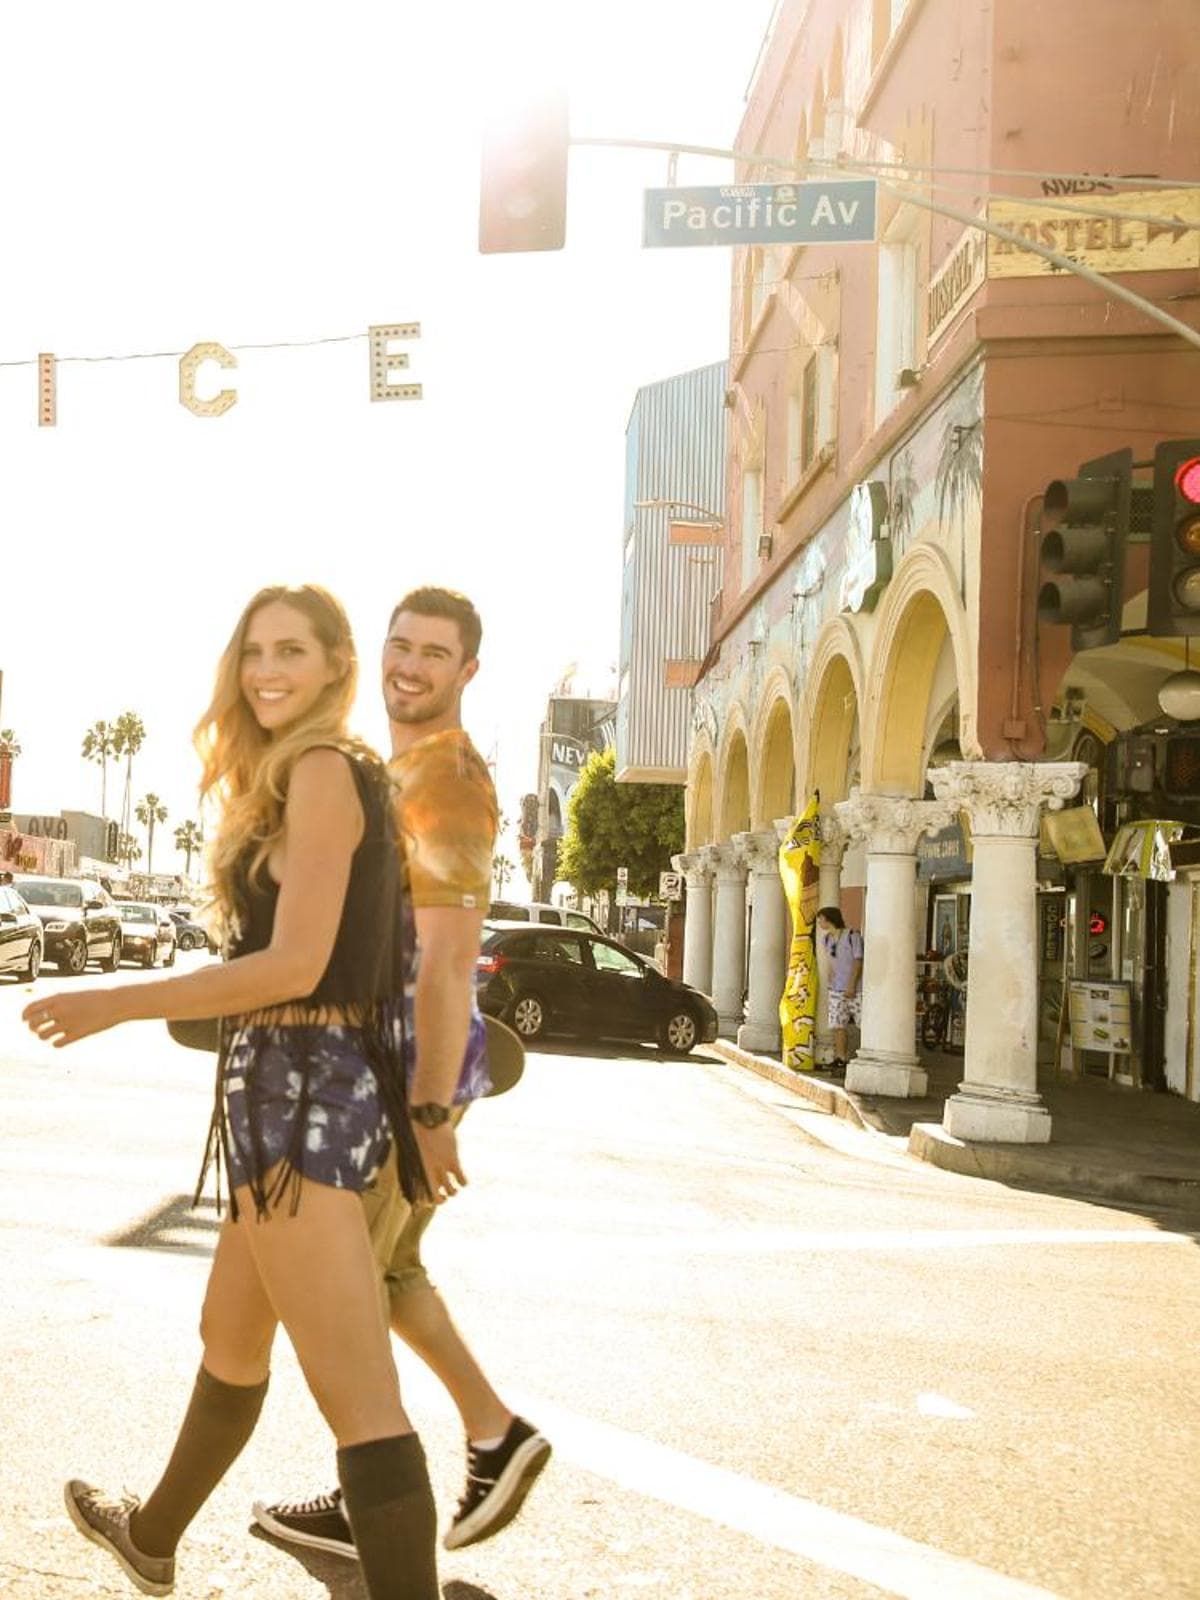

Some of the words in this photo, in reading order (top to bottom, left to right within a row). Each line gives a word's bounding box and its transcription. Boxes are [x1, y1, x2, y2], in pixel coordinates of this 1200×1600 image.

[662, 196, 797, 230] Pacific
[811, 195, 860, 227] Av
[994, 217, 1133, 255] HOSTEL
